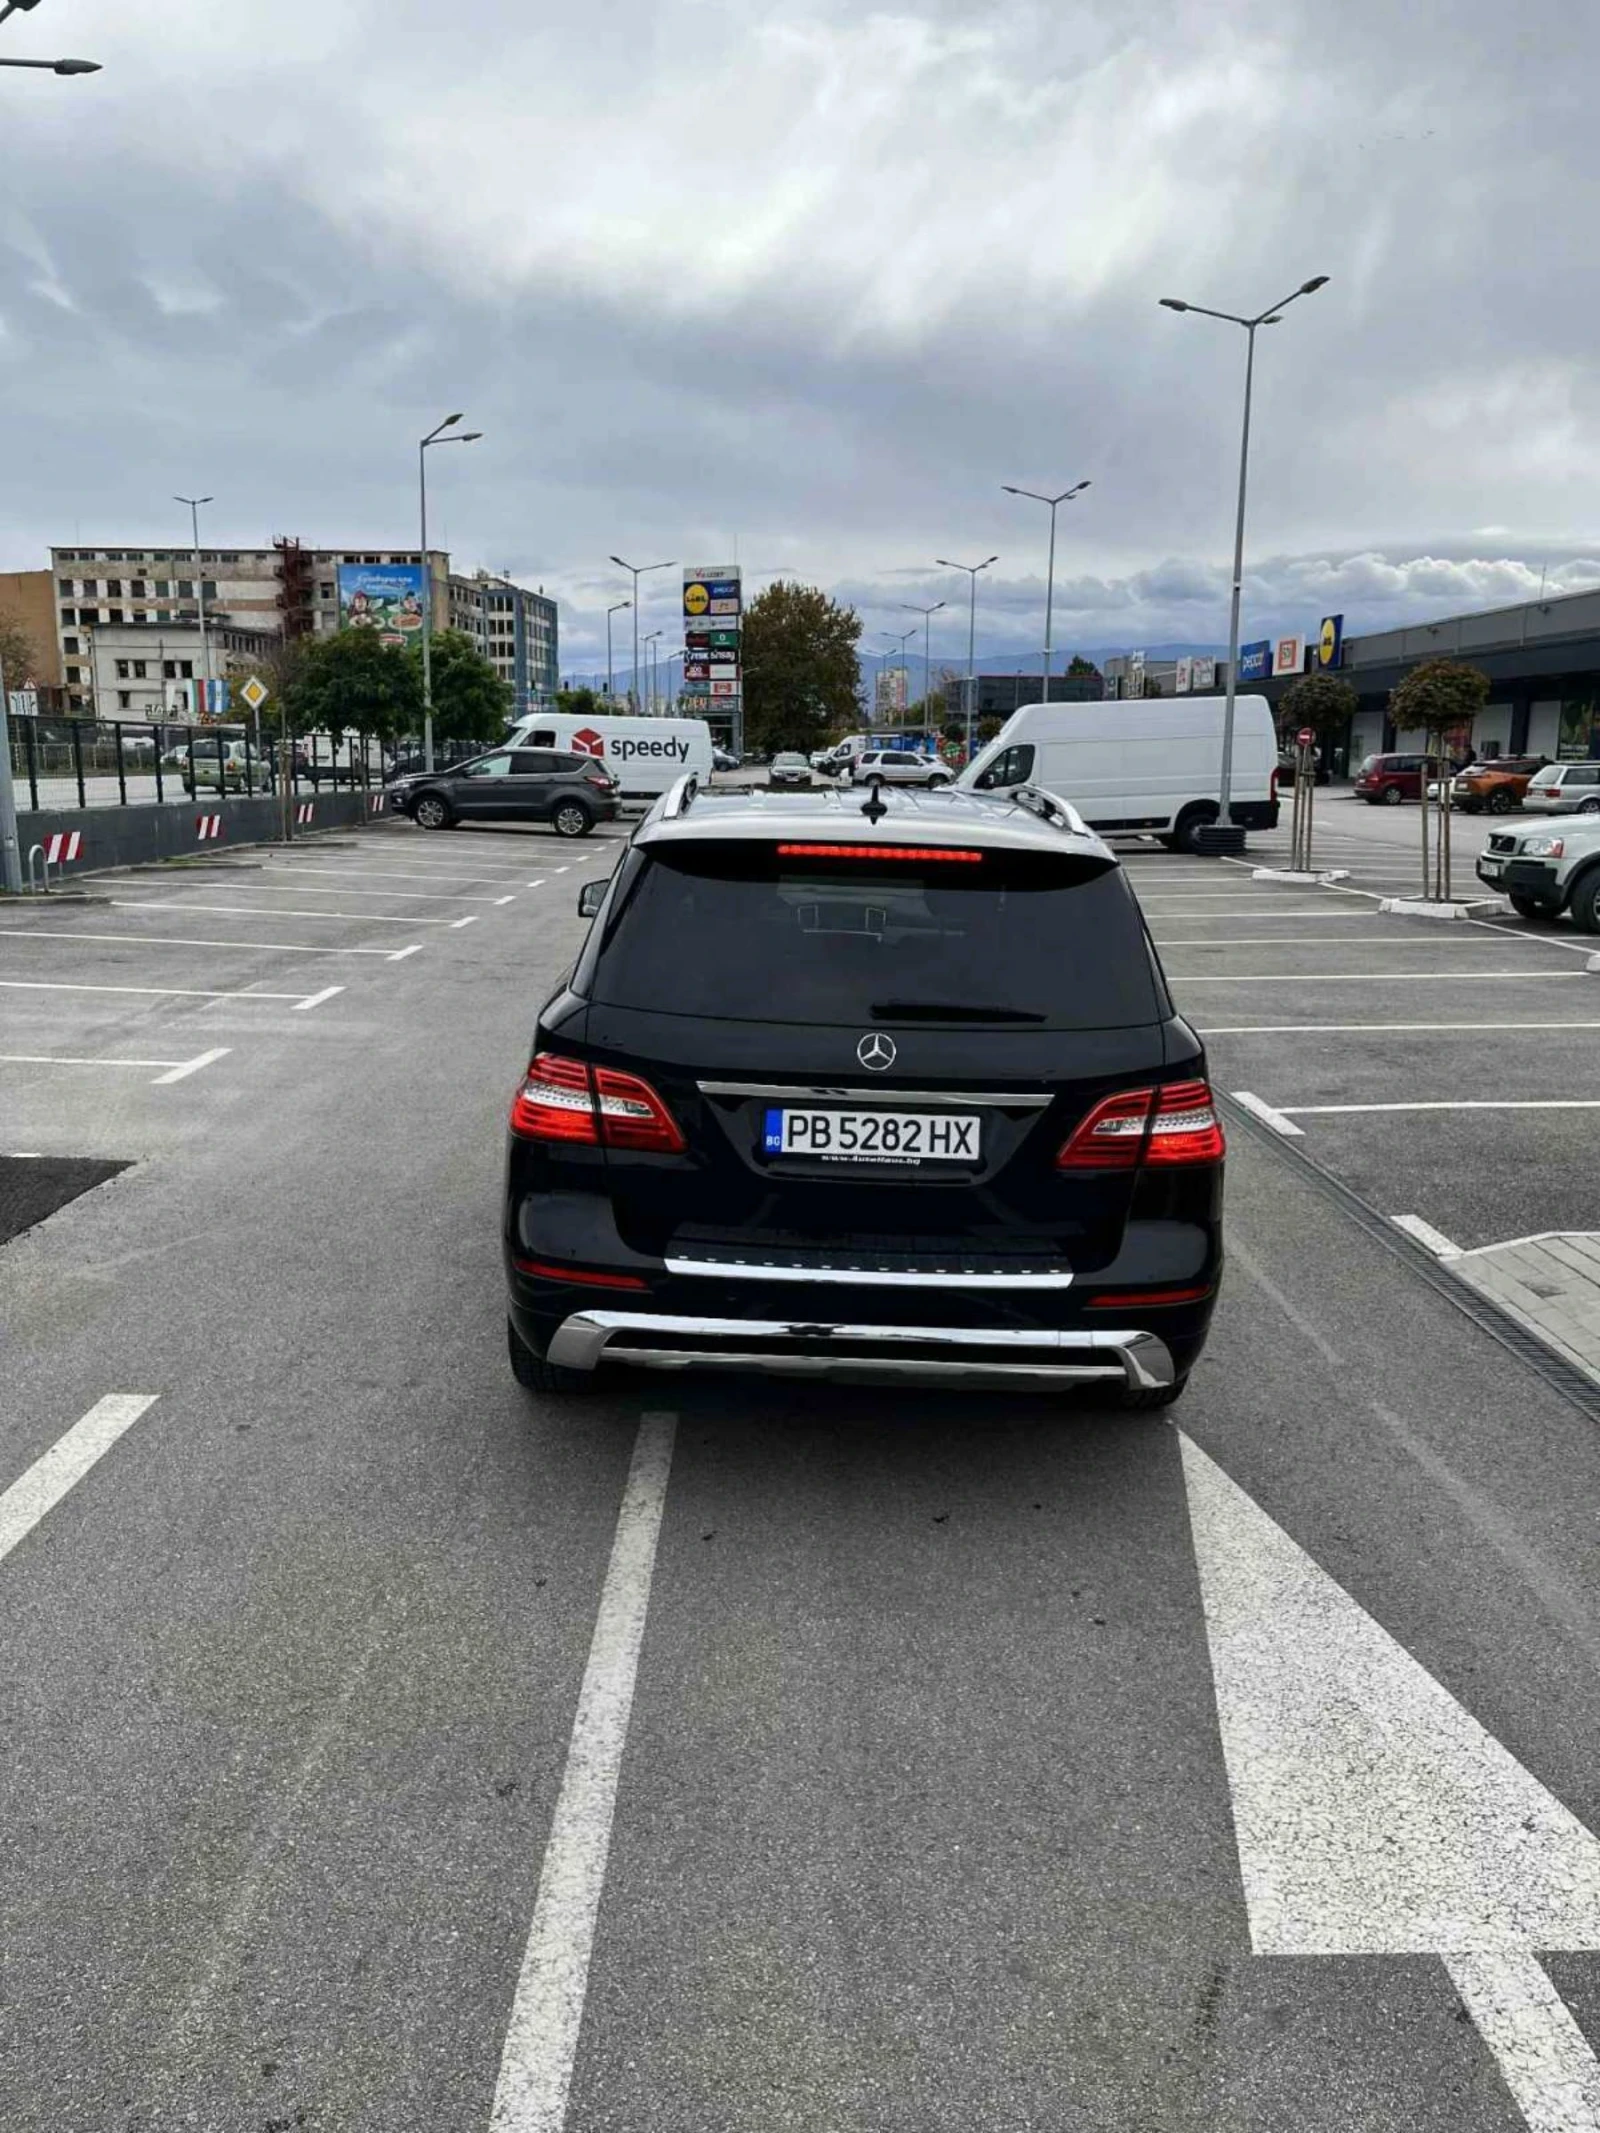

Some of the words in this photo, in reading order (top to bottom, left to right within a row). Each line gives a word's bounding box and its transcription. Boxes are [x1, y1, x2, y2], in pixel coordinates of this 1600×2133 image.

[611, 736, 689, 763] speedy
[766, 1135, 780, 1146] BG
[787, 1115, 831, 1149] PB
[839, 1117, 922, 1152] 5282
[929, 1120, 973, 1154] HX
